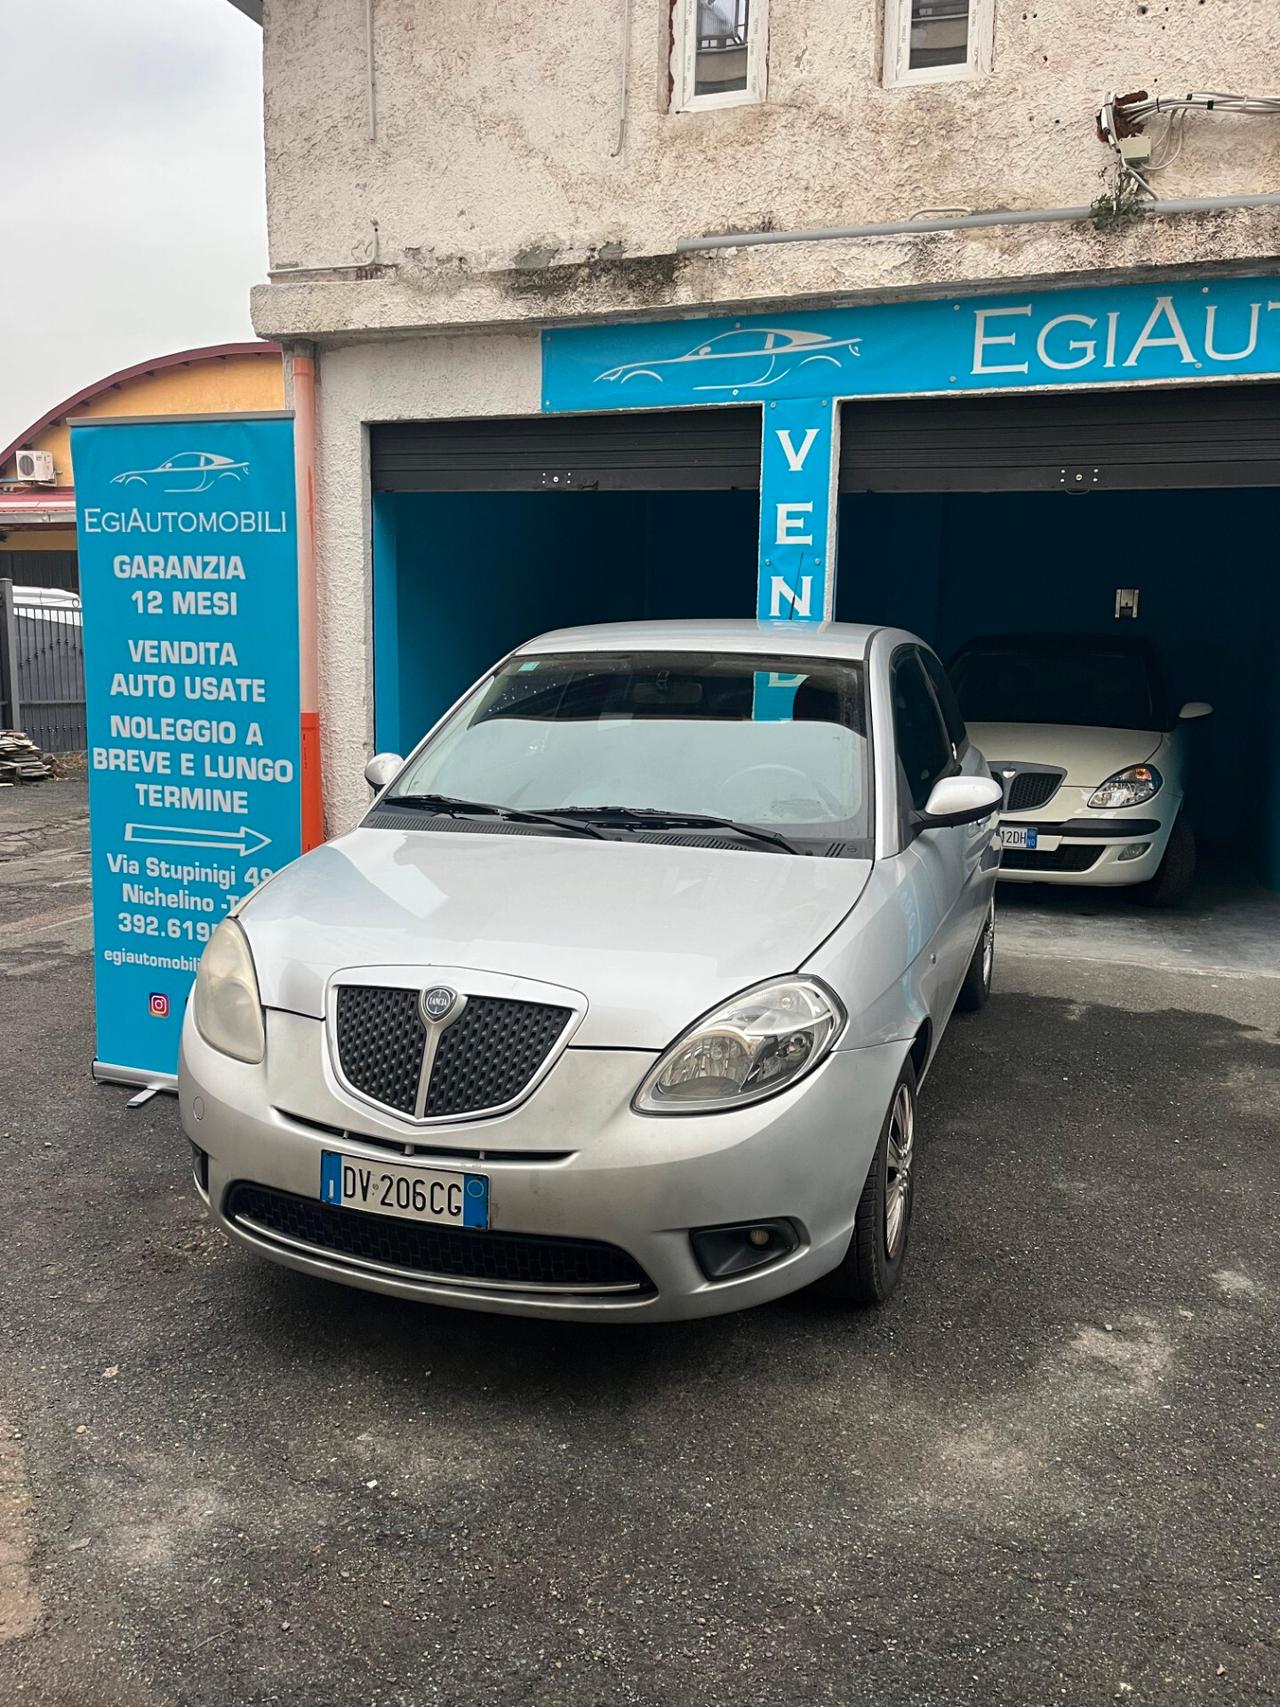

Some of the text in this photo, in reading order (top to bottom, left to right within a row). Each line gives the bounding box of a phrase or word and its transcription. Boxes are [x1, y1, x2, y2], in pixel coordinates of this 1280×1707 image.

[970, 297, 1280, 374] EGIAU
[113, 555, 246, 580] GARANZIA
[131, 591, 238, 616] 12 MESI
[128, 640, 238, 666] VENDITA
[110, 673, 266, 703] AUTO USATE
[110, 715, 264, 746] NOLEGGIO A
[92, 747, 293, 783] BREVE E LUNGO
[135, 783, 248, 814] TERMINE
[107, 853, 139, 874] Via
[146, 857, 235, 890] Stupinigi
[122, 883, 214, 912] Nichelino
[118, 912, 216, 942] 392.619
